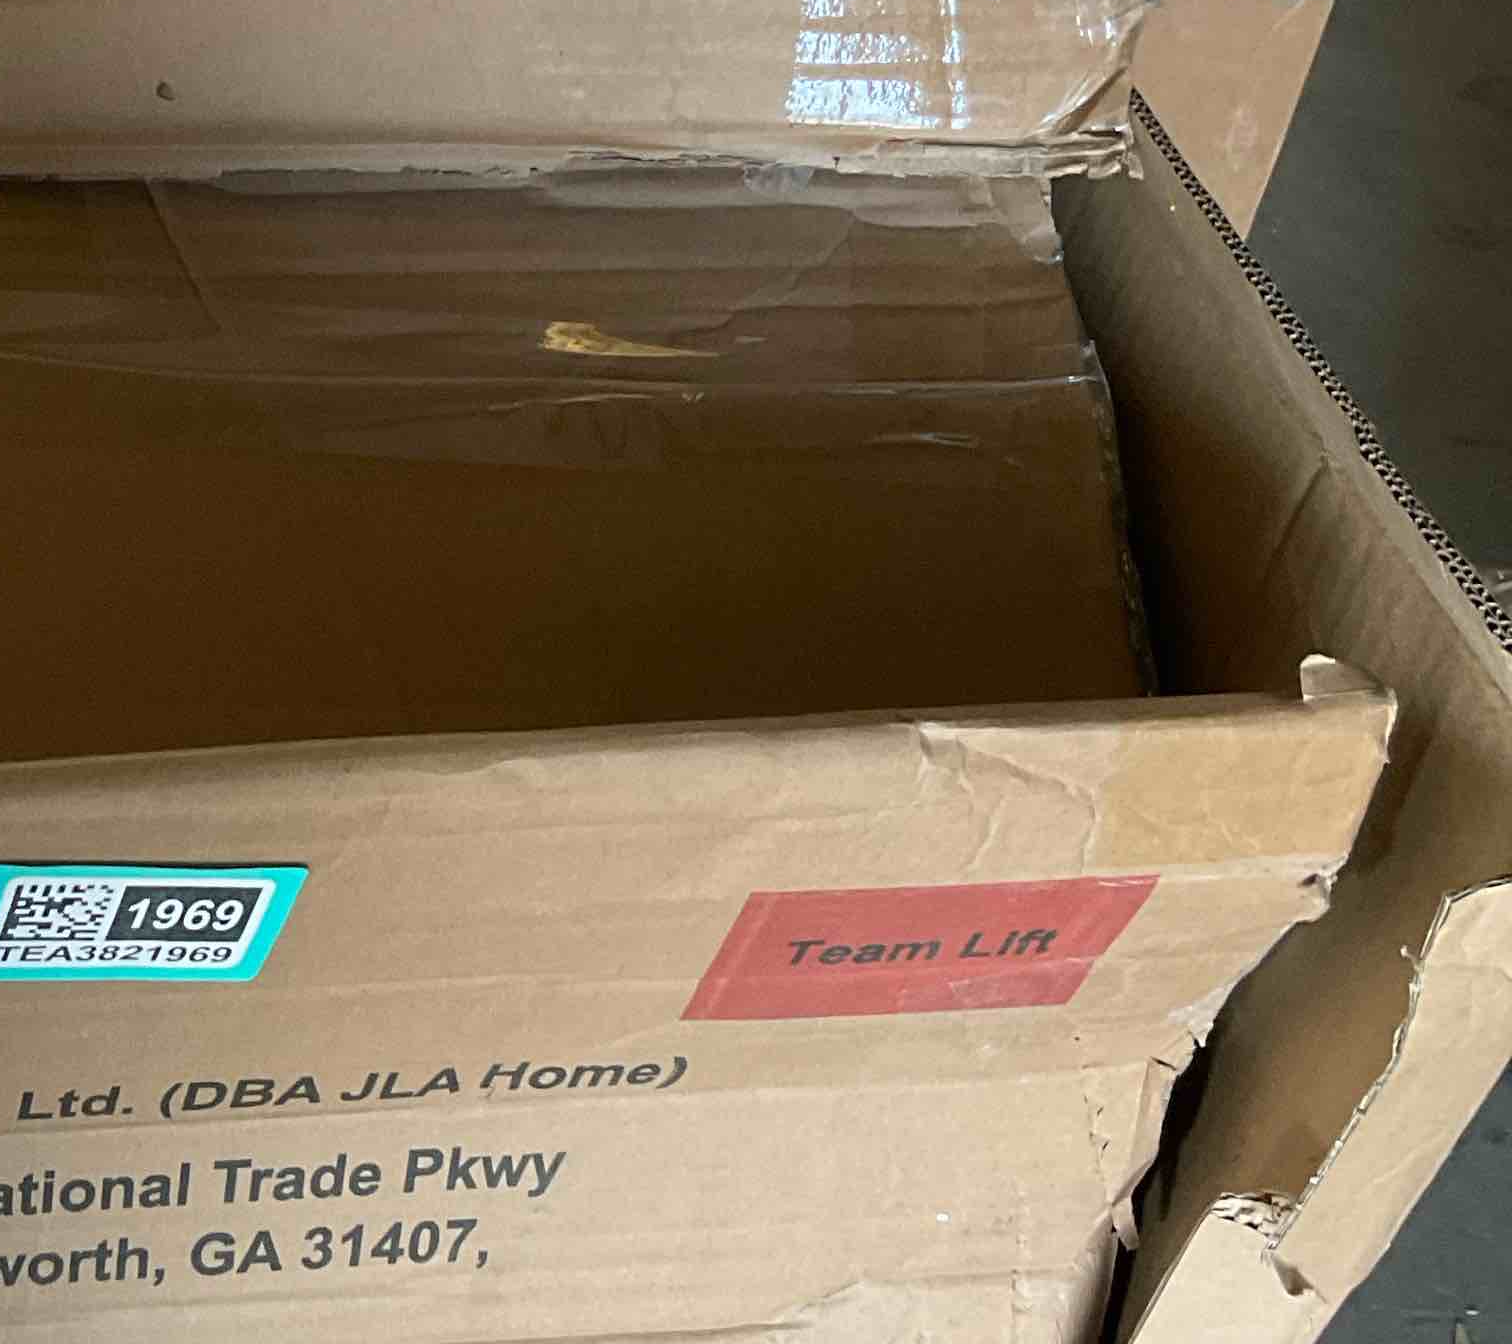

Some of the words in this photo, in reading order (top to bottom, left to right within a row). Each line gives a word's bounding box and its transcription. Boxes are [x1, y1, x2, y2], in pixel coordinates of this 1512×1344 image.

[126, 897, 245, 932] 1969
[787, 936, 940, 967] Team
[959, 928, 1059, 959] Lift
[15, 1084, 135, 1123] Ltd.
[159, 1074, 322, 1120] (DBA
[340, 1067, 462, 1102] JLA
[479, 1056, 690, 1095] Home)
[214, 1153, 382, 1206] Trade
[404, 1145, 567, 1199] Pkwy
[189, 1230, 283, 1276] GA
[301, 1219, 490, 1271] 31407,
